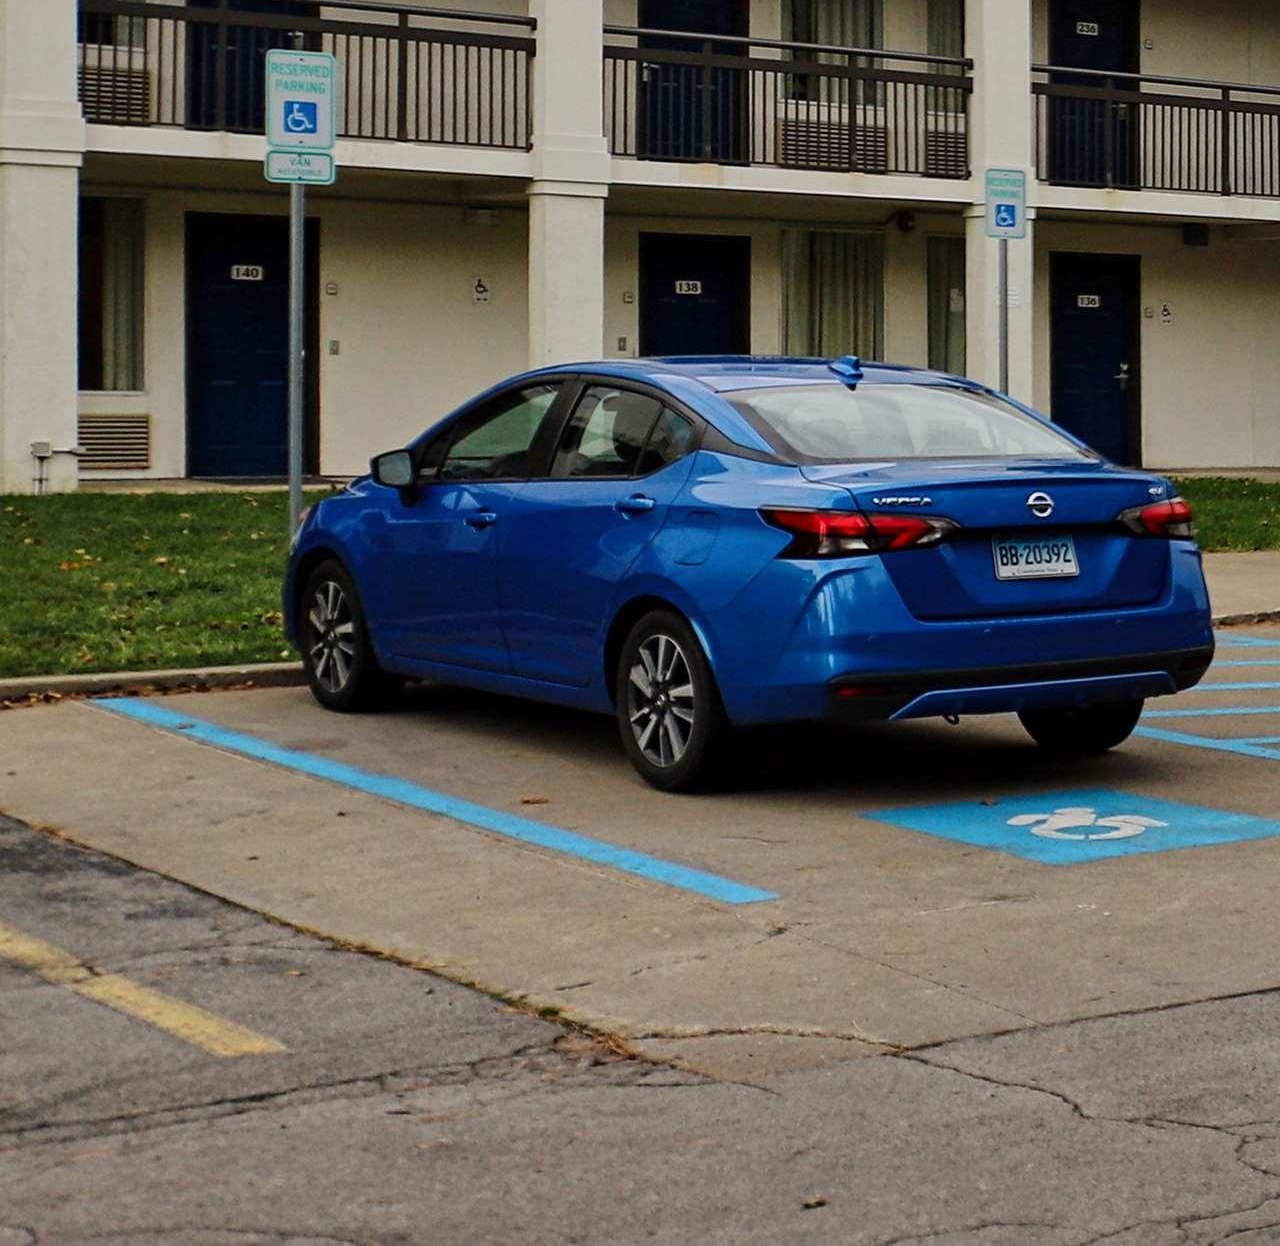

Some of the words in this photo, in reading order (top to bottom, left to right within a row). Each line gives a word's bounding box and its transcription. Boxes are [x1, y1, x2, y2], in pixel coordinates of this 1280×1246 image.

[270, 63, 330, 78] RESERVED
[275, 79, 326, 94] PARKING
[289, 158, 311, 167] VAN
[235, 267, 260, 278] 140
[678, 282, 698, 293] 138
